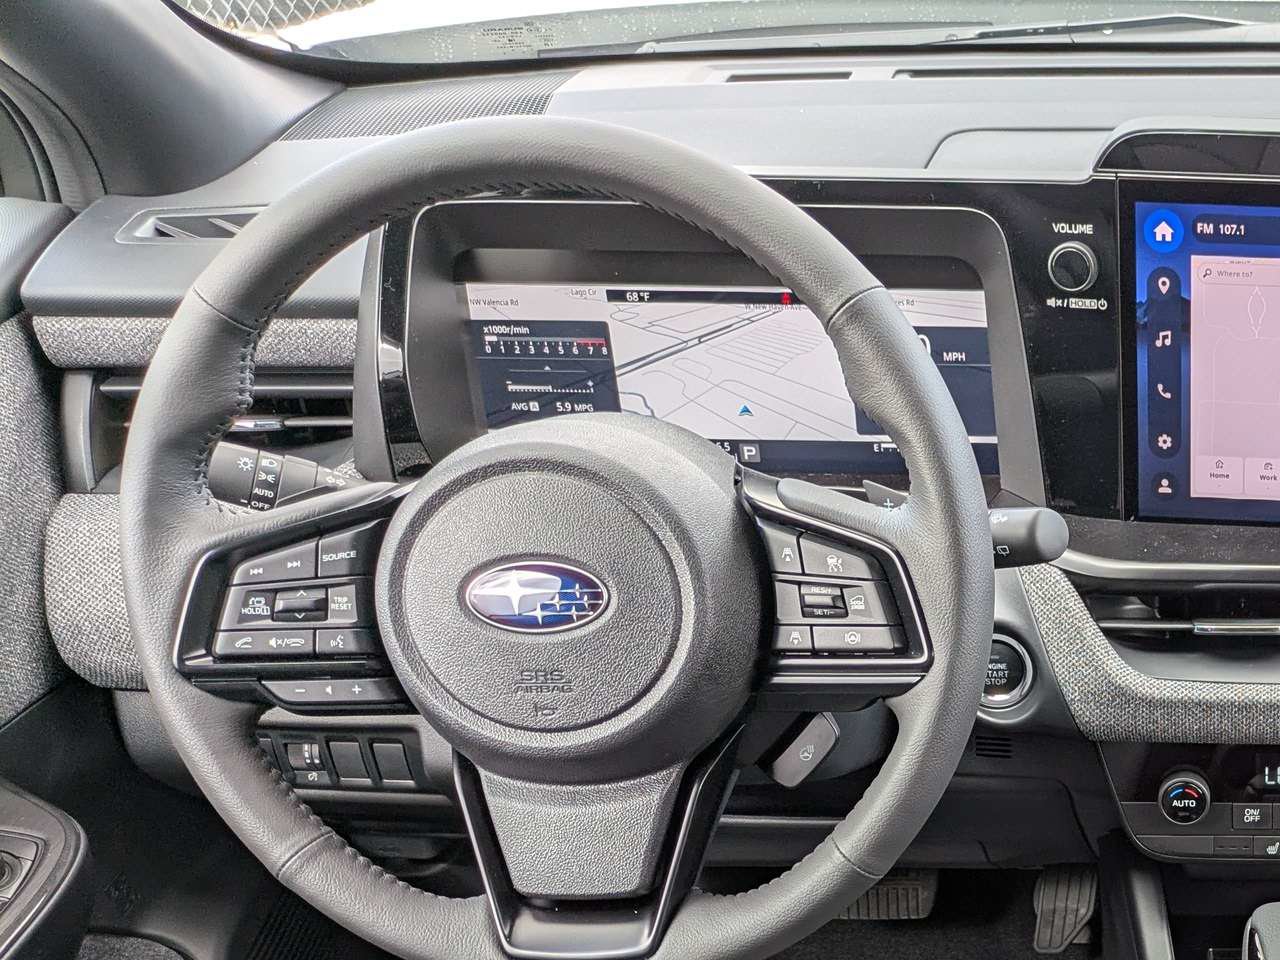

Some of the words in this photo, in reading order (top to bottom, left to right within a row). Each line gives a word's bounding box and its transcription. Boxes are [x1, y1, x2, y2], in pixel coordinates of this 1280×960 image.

[1052, 223, 1094, 234] VOLUME
[1197, 223, 1214, 234] FM
[1219, 224, 1245, 235] 107.1
[1216, 270, 1241, 278] Where
[485, 346, 491, 355] 0
[500, 346, 505, 355] 1
[514, 346, 520, 355] 2
[529, 346, 535, 355] 3
[543, 346, 549, 355] 4
[558, 346, 564, 355] 5
[572, 346, 579, 355] 6
[587, 346, 594, 355] 7
[601, 346, 608, 355] 8
[943, 352, 966, 361] MPH
[511, 402, 528, 411] AVG
[556, 402, 572, 411] 5.9
[574, 403, 594, 411] MPG
[743, 446, 756, 460] P
[253, 487, 274, 498] AUTO
[252, 501, 271, 510] OFF
[322, 550, 357, 562] SOURCE
[985, 670, 1009, 678] TART
[1244, 808, 1260, 816] ON/
[1244, 815, 1260, 823] OFF
